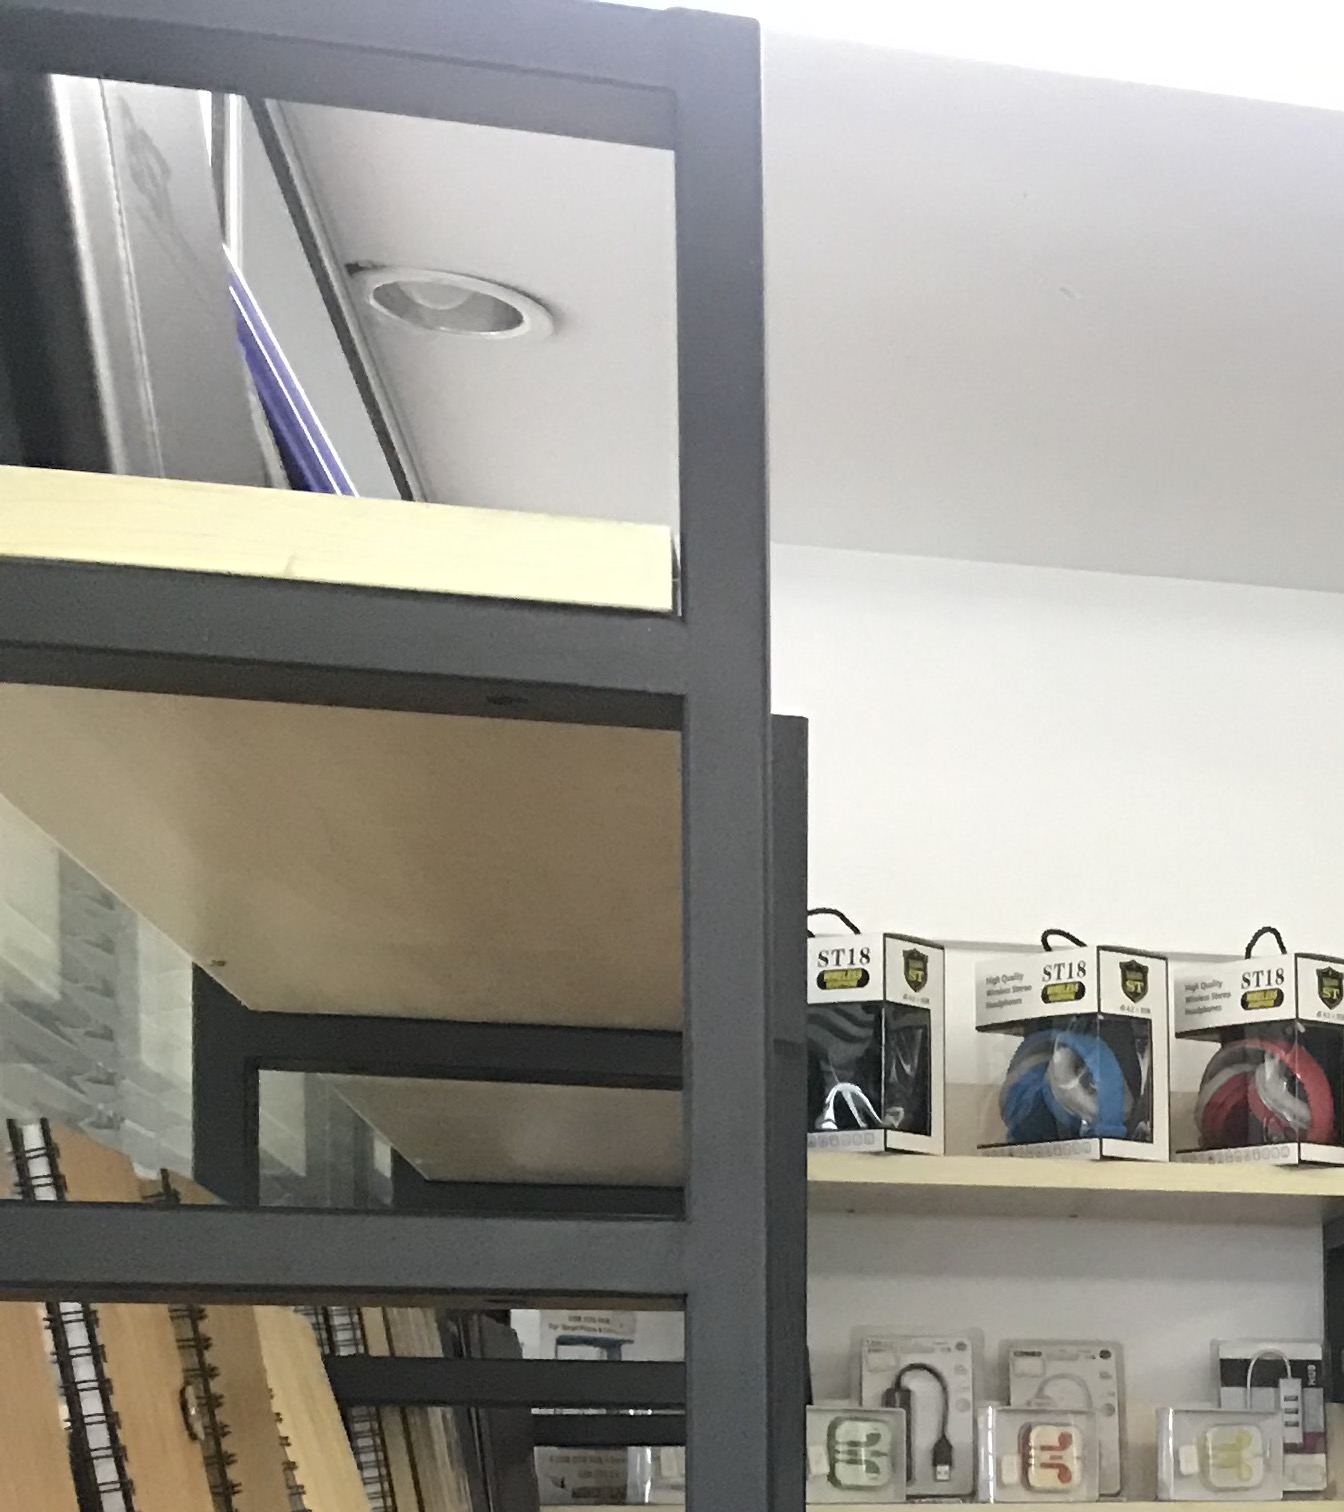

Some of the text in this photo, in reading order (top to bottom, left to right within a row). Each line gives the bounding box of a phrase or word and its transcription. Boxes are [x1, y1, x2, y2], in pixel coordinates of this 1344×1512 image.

[817, 947, 871, 968] ST18
[1042, 960, 1087, 982] ST18
[1241, 968, 1286, 989] ST18
[1321, 987, 1340, 999] ST
